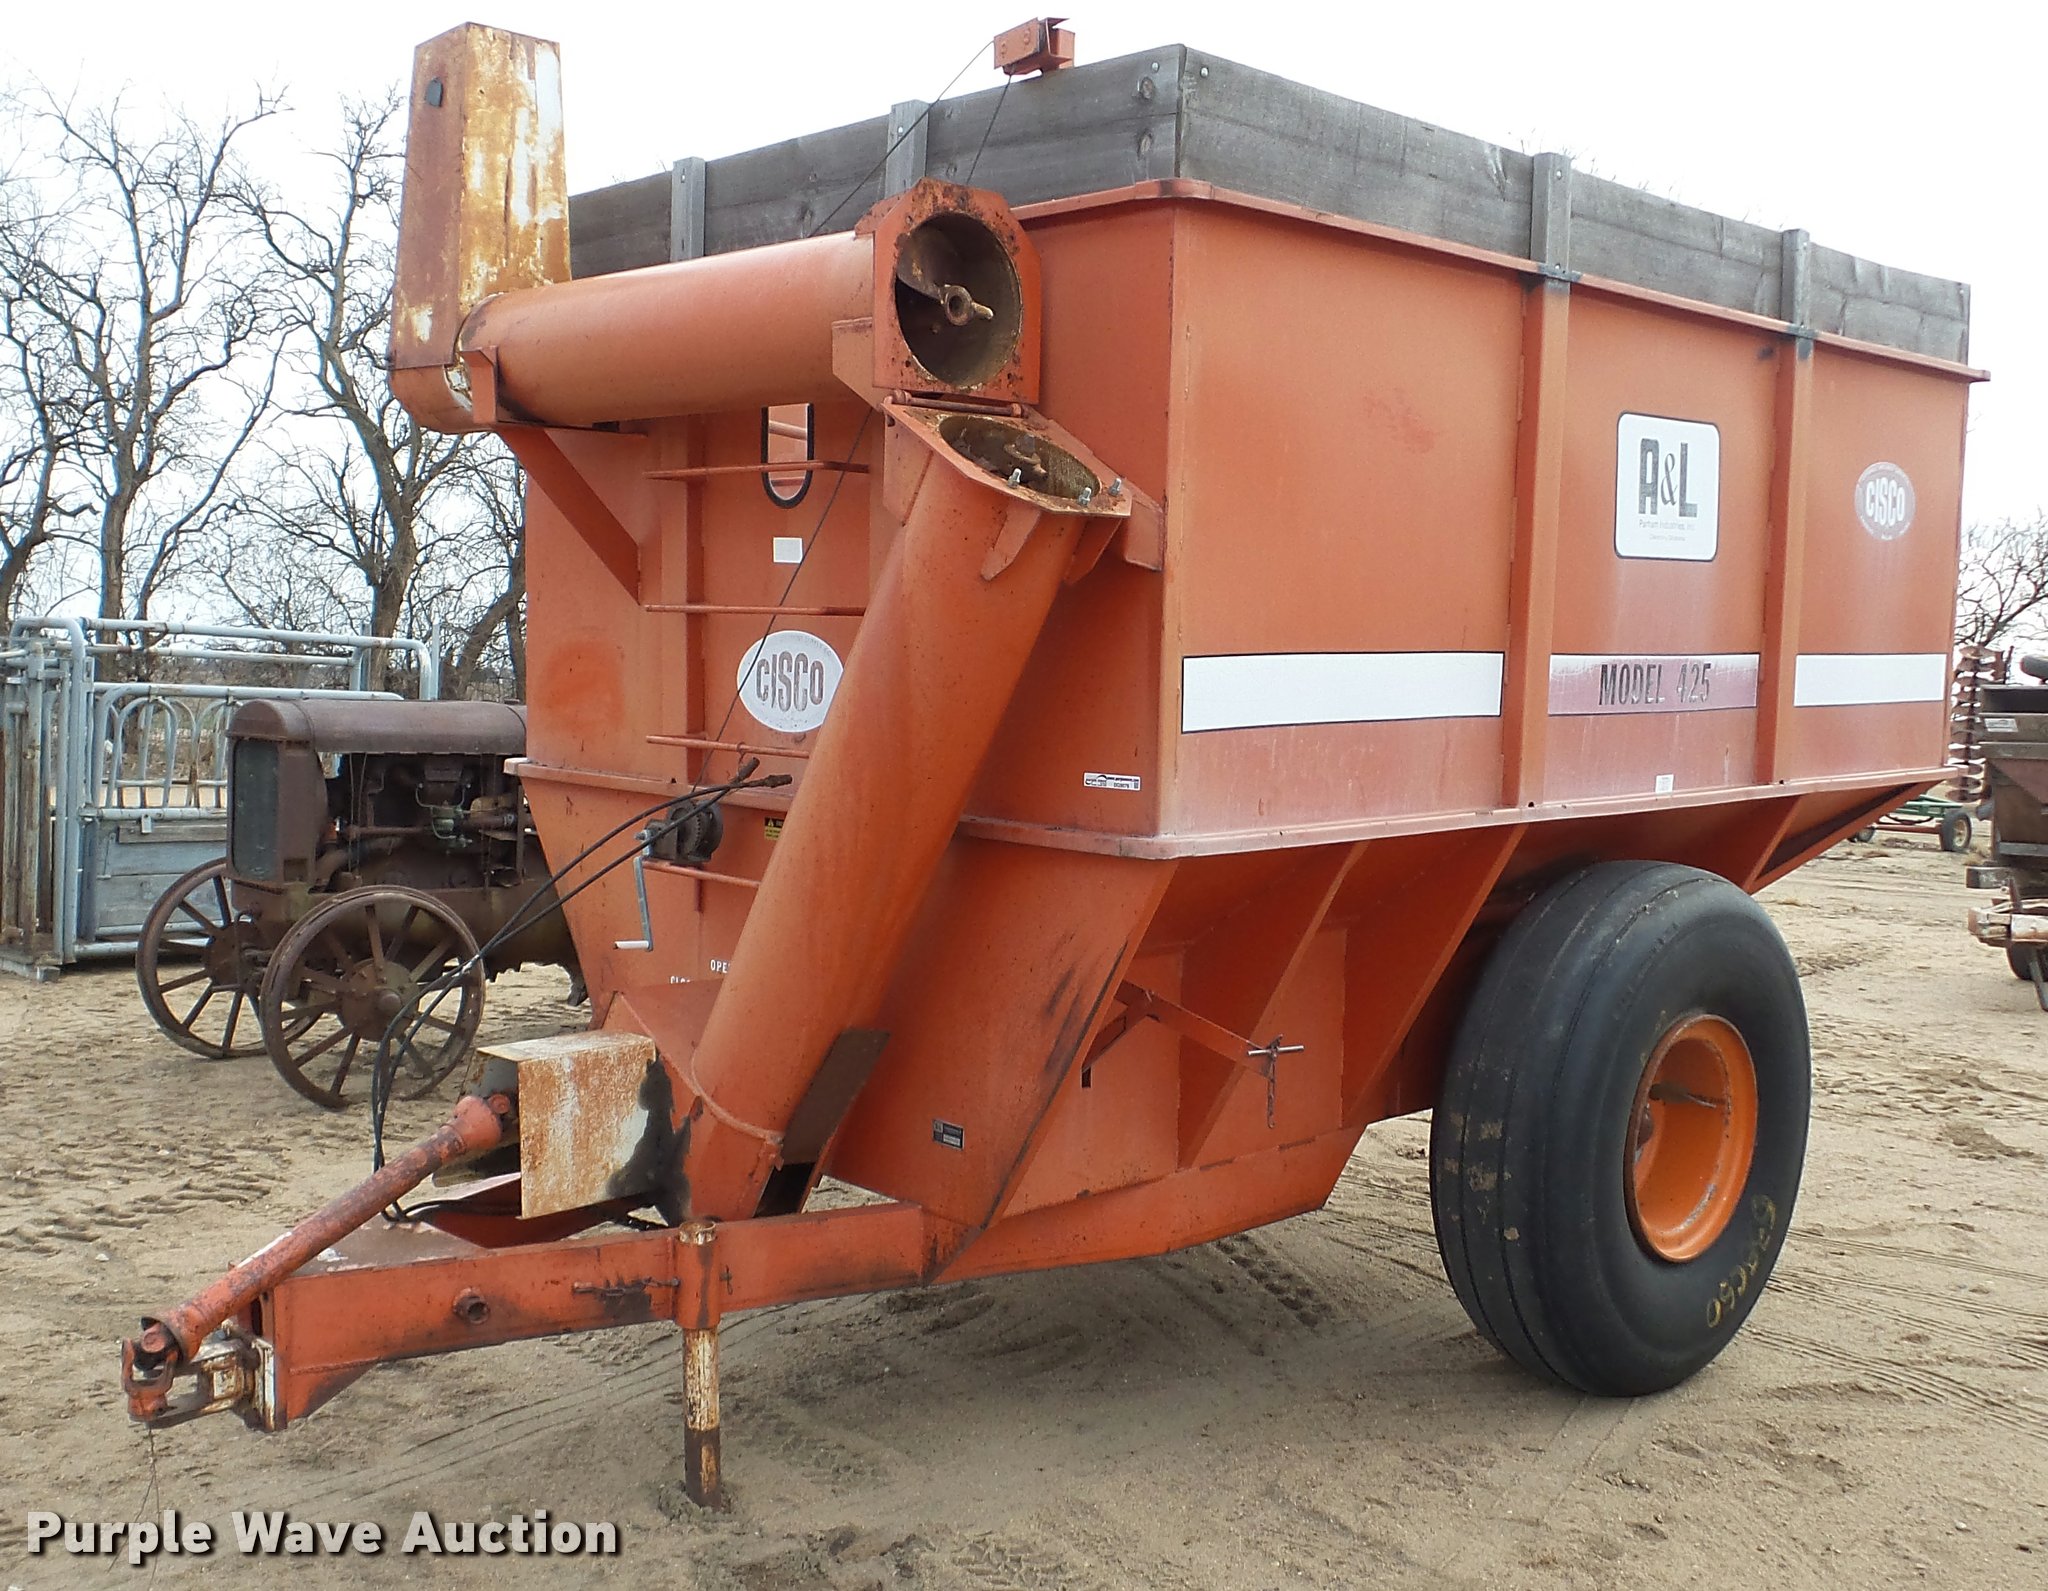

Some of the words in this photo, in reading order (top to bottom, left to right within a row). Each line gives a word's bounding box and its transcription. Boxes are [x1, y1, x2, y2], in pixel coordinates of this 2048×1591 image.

[1638, 438, 1698, 518] A&L
[1866, 477, 1906, 527] CISCO
[756, 651, 825, 713] CISCO
[1598, 663, 1665, 705] MODEL
[1677, 663, 1711, 703] 425
[710, 959, 731, 974] OPE
